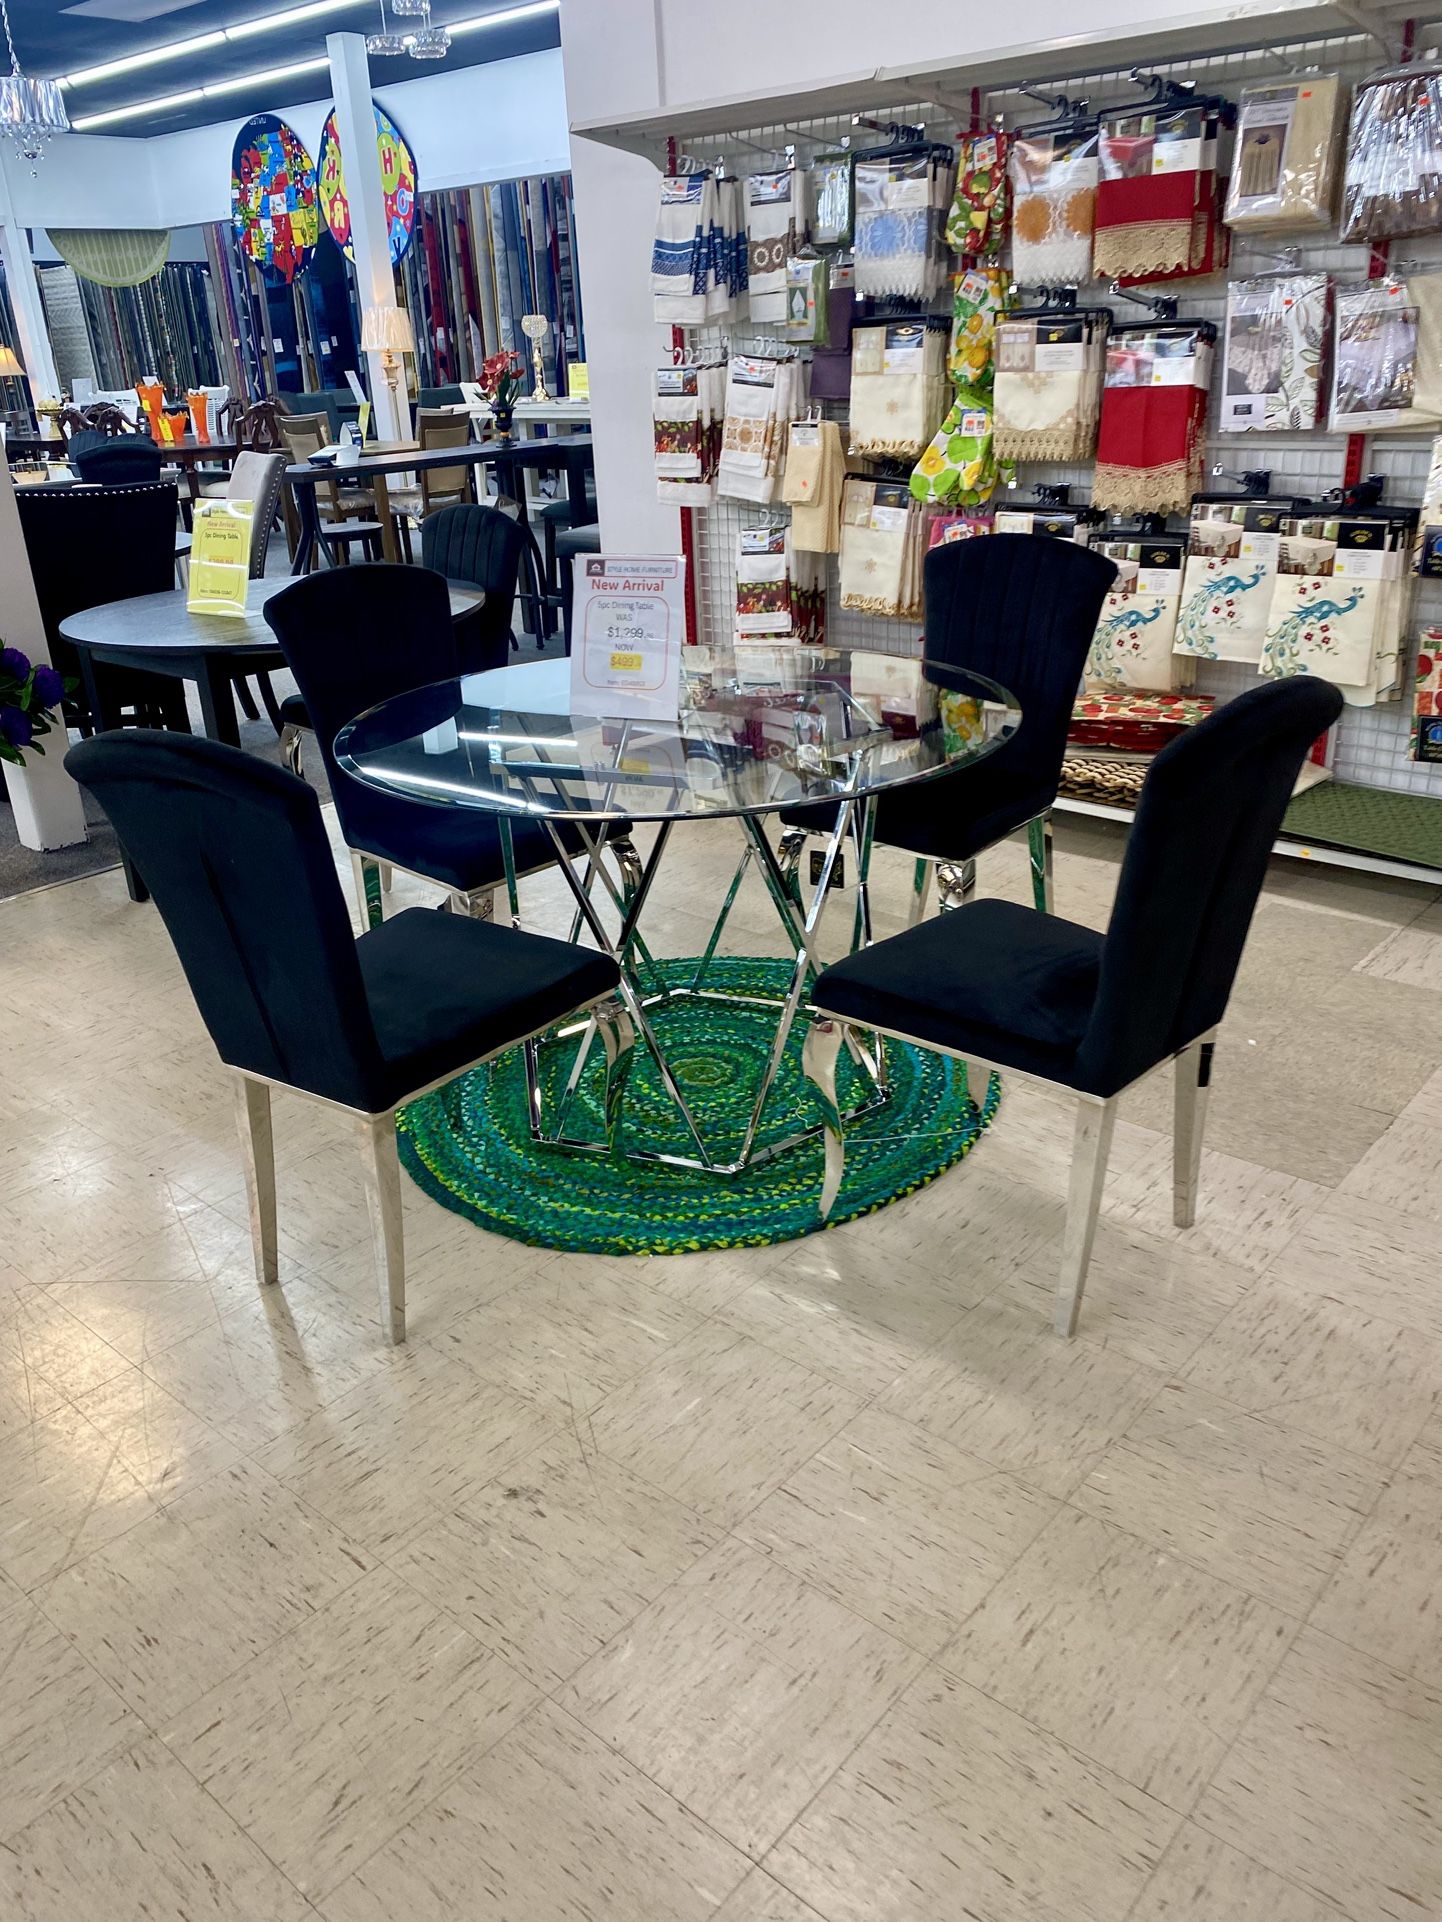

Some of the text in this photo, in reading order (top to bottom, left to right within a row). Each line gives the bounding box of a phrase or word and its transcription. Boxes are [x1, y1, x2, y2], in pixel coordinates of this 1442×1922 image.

[591, 578, 665, 592] New Arrival
[612, 601, 635, 611] Dining
[636, 601, 654, 610] Table
[616, 614, 633, 622] WAS
[615, 643, 634, 651] NOW
